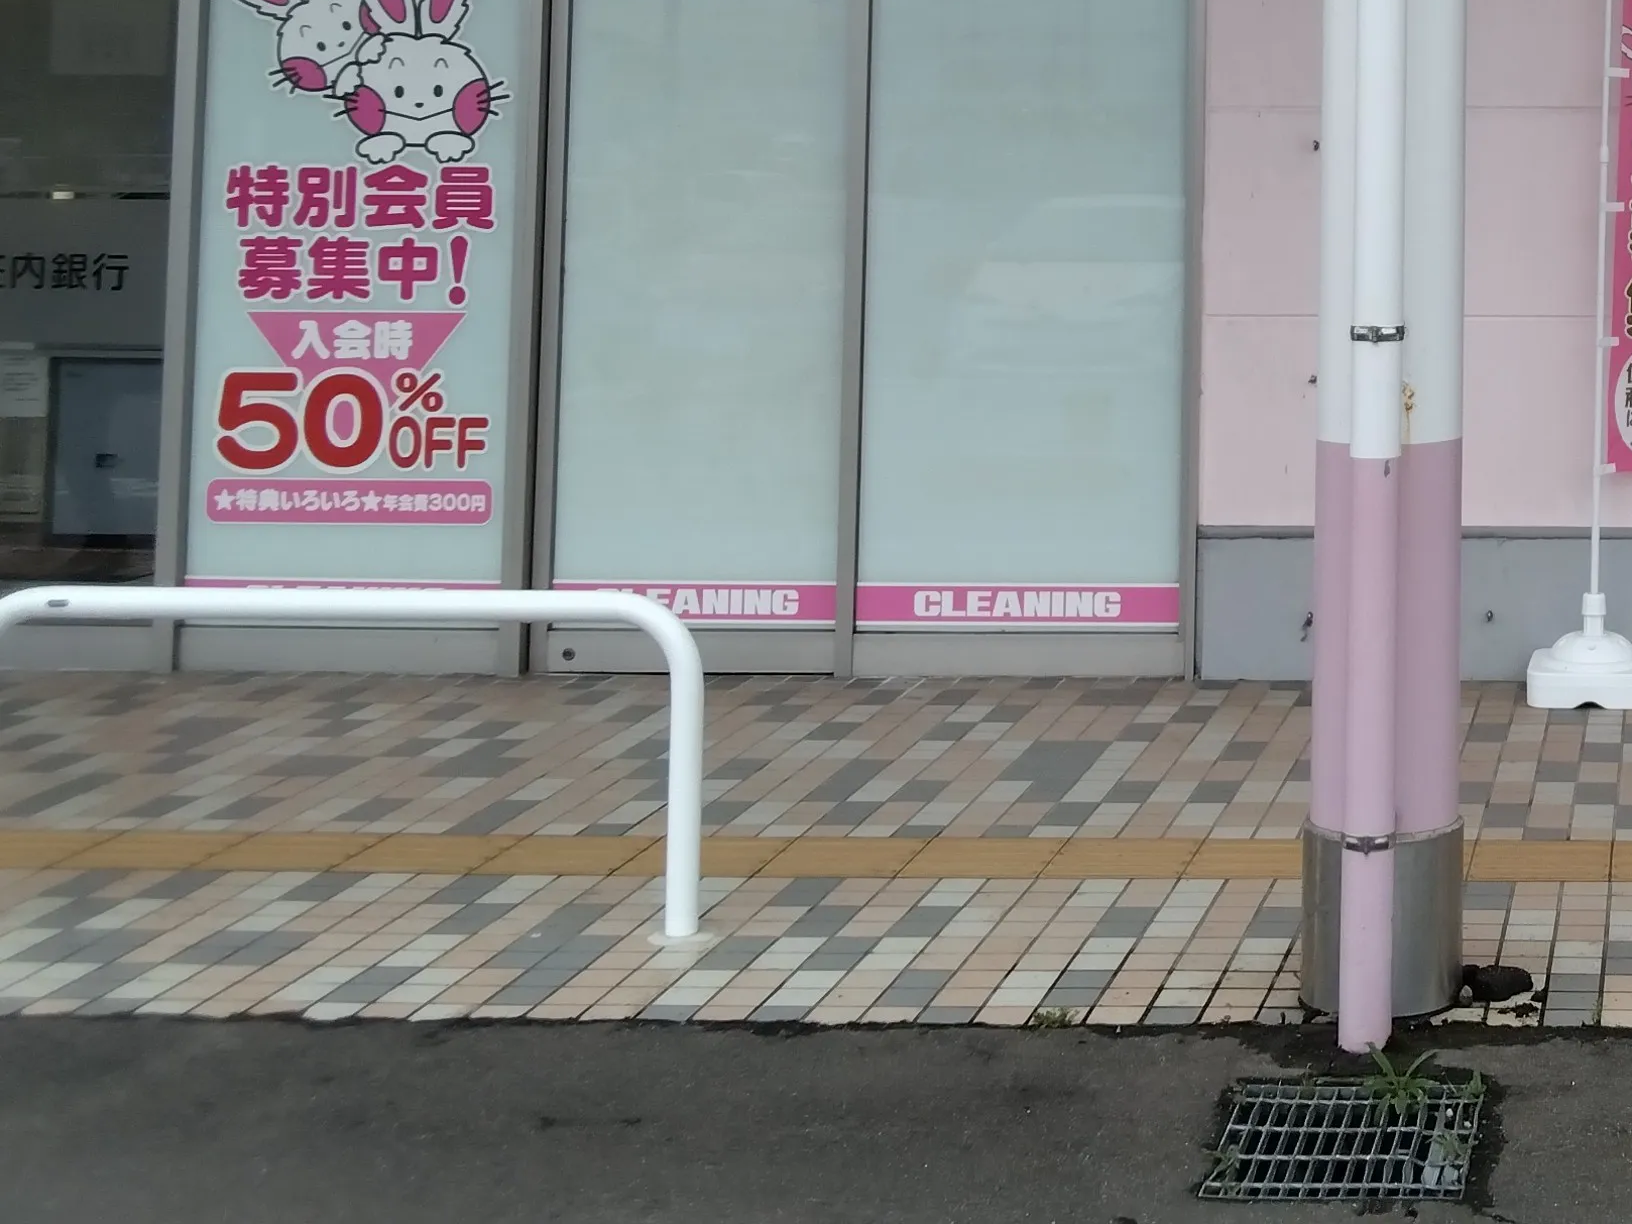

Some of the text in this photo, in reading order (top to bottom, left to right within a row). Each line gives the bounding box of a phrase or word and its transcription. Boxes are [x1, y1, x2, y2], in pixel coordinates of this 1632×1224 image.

[226, 165, 494, 229] 特別会員
[0, 253, 130, 291] 内銀行
[238, 236, 469, 305] 募集中!
[291, 320, 413, 361] 入会時
[216, 371, 383, 470] 50
[388, 416, 490, 469] OFF
[597, 588, 799, 615] EANING
[914, 590, 1122, 618] CLEANING
